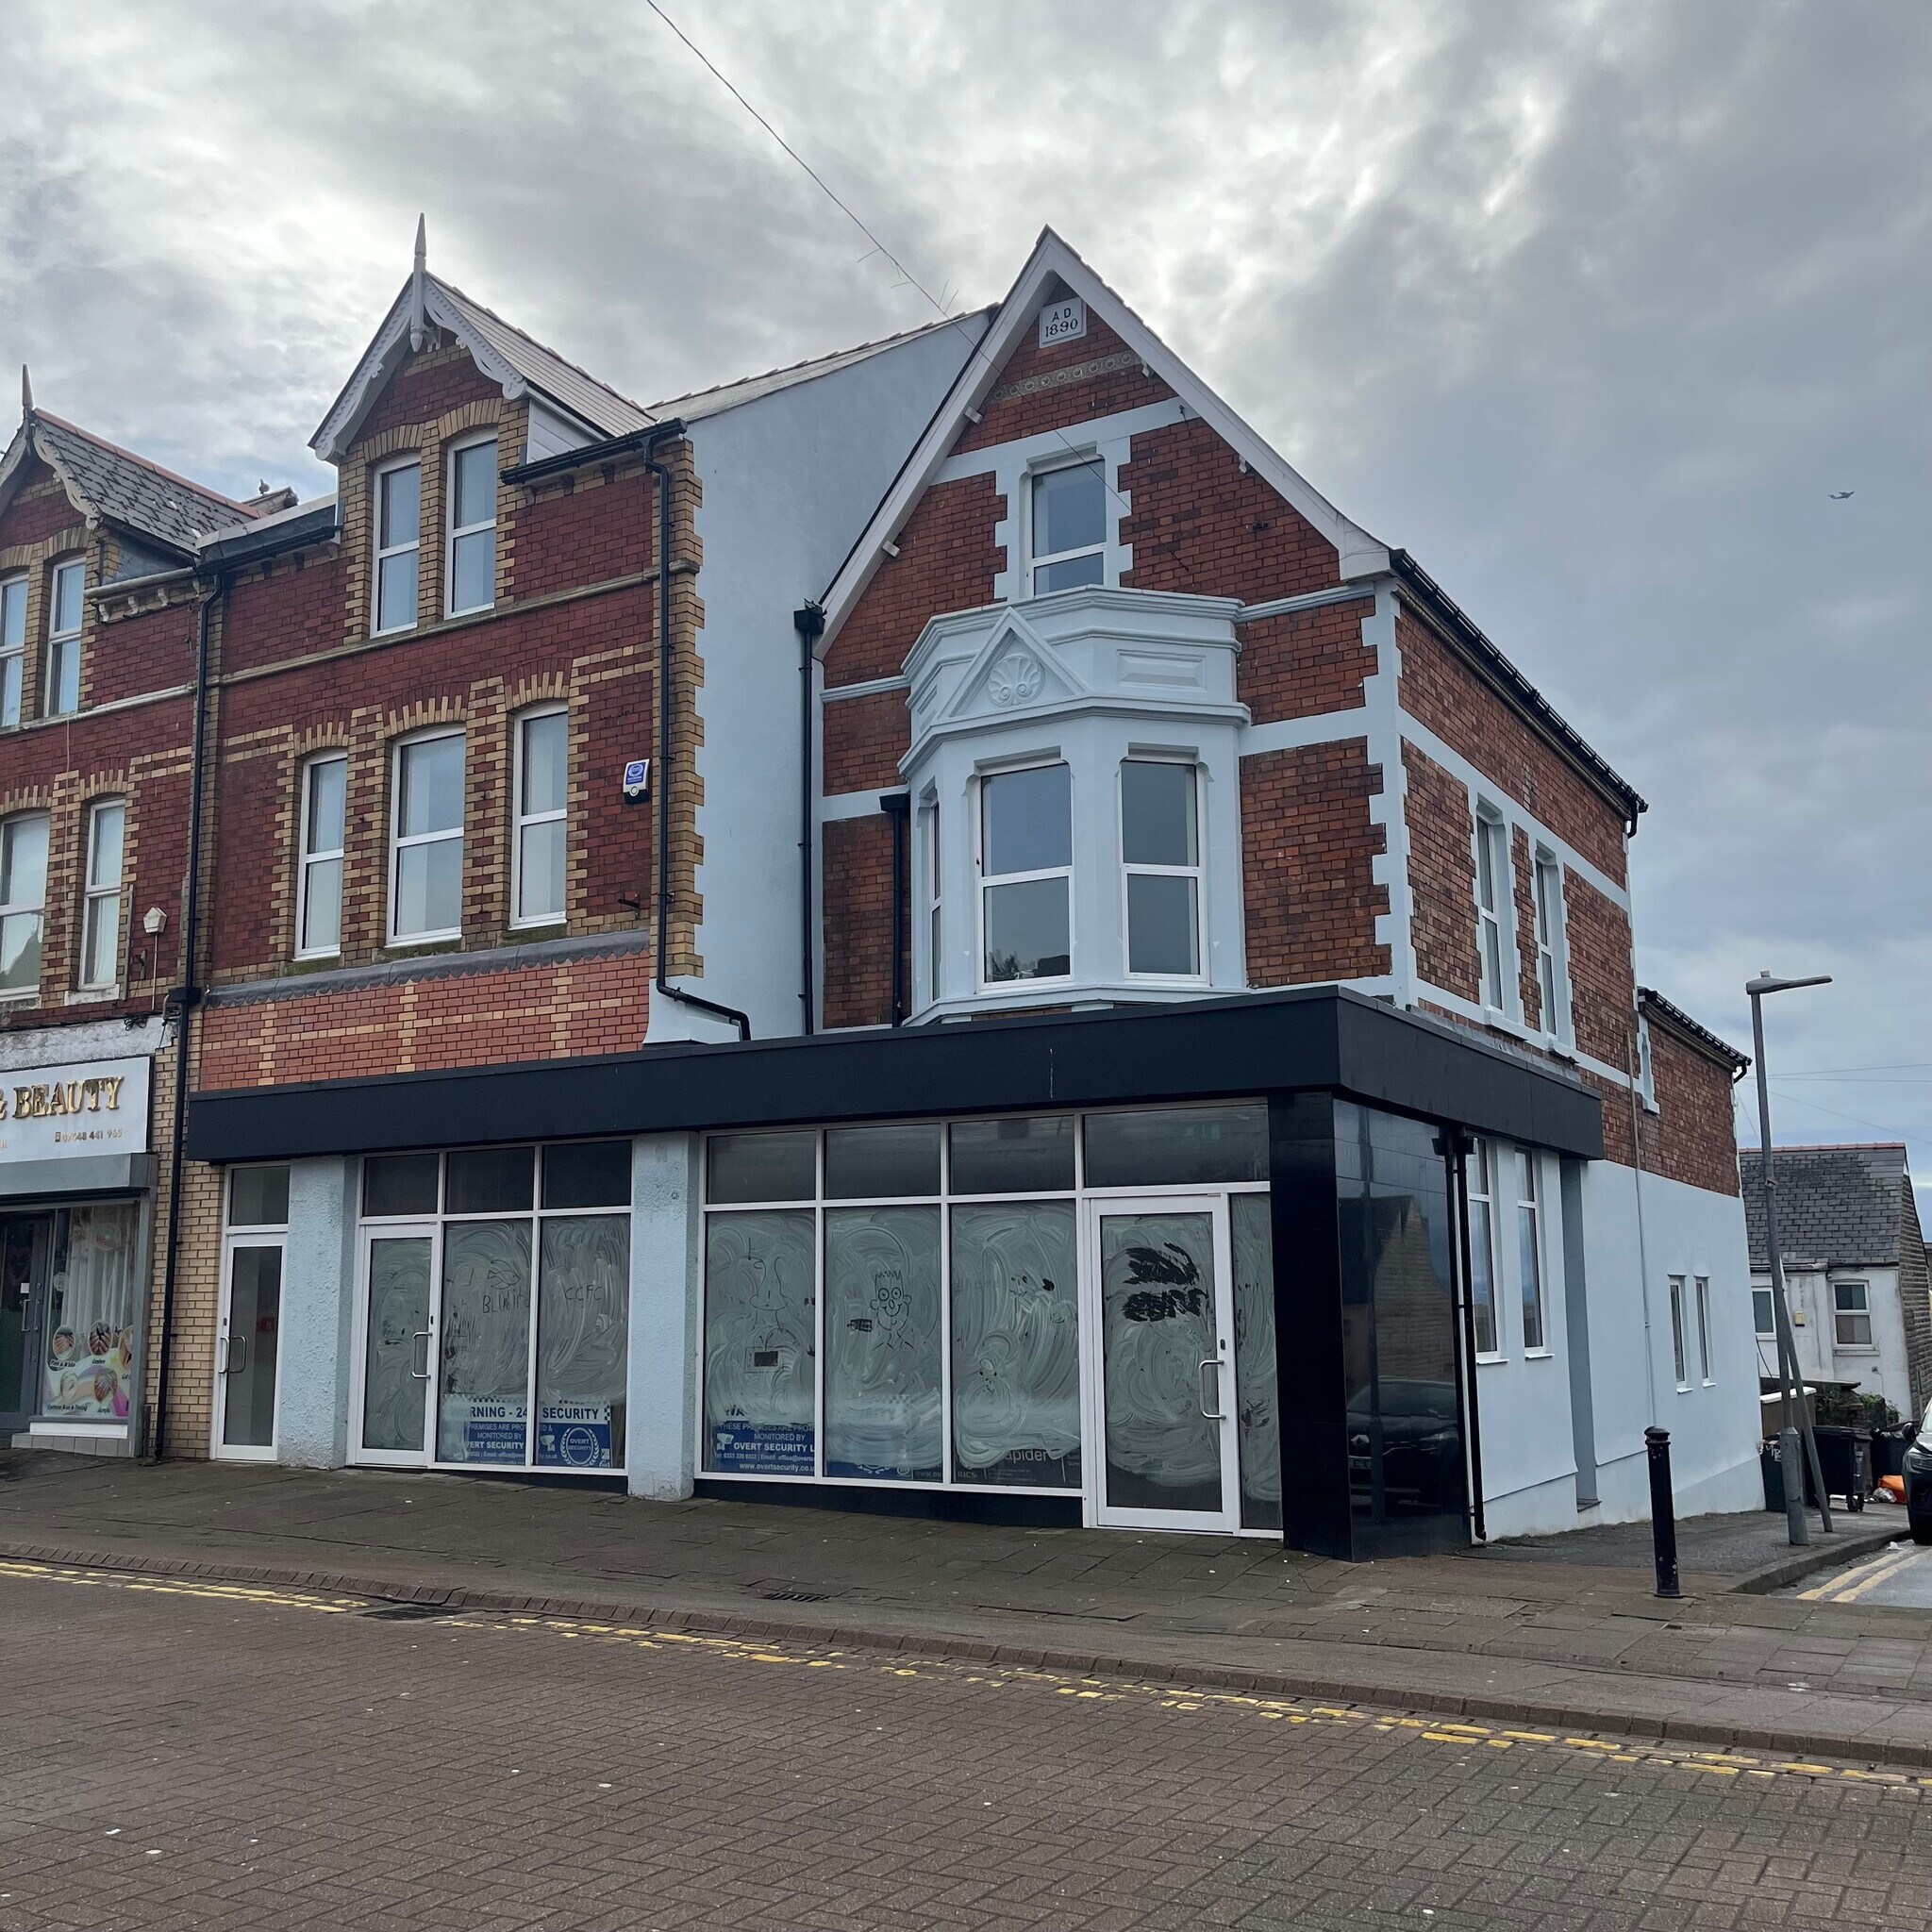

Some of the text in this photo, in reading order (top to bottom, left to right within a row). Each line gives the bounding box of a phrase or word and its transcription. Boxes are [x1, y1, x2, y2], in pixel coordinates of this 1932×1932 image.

[1045, 318, 1078, 337] 1890
[12, 1076, 125, 1119] BEAUTY
[471, 1407, 506, 1418] RNING
[542, 1407, 599, 1420] SECURITY
[754, 1433, 794, 1441] MONITORED
[734, 1442, 762, 1451] OVERT
[764, 1443, 808, 1453] SECURITY
[1004, 1449, 1047, 1464] apider
[740, 1463, 814, 1473] www.overtsecurity.co.u
